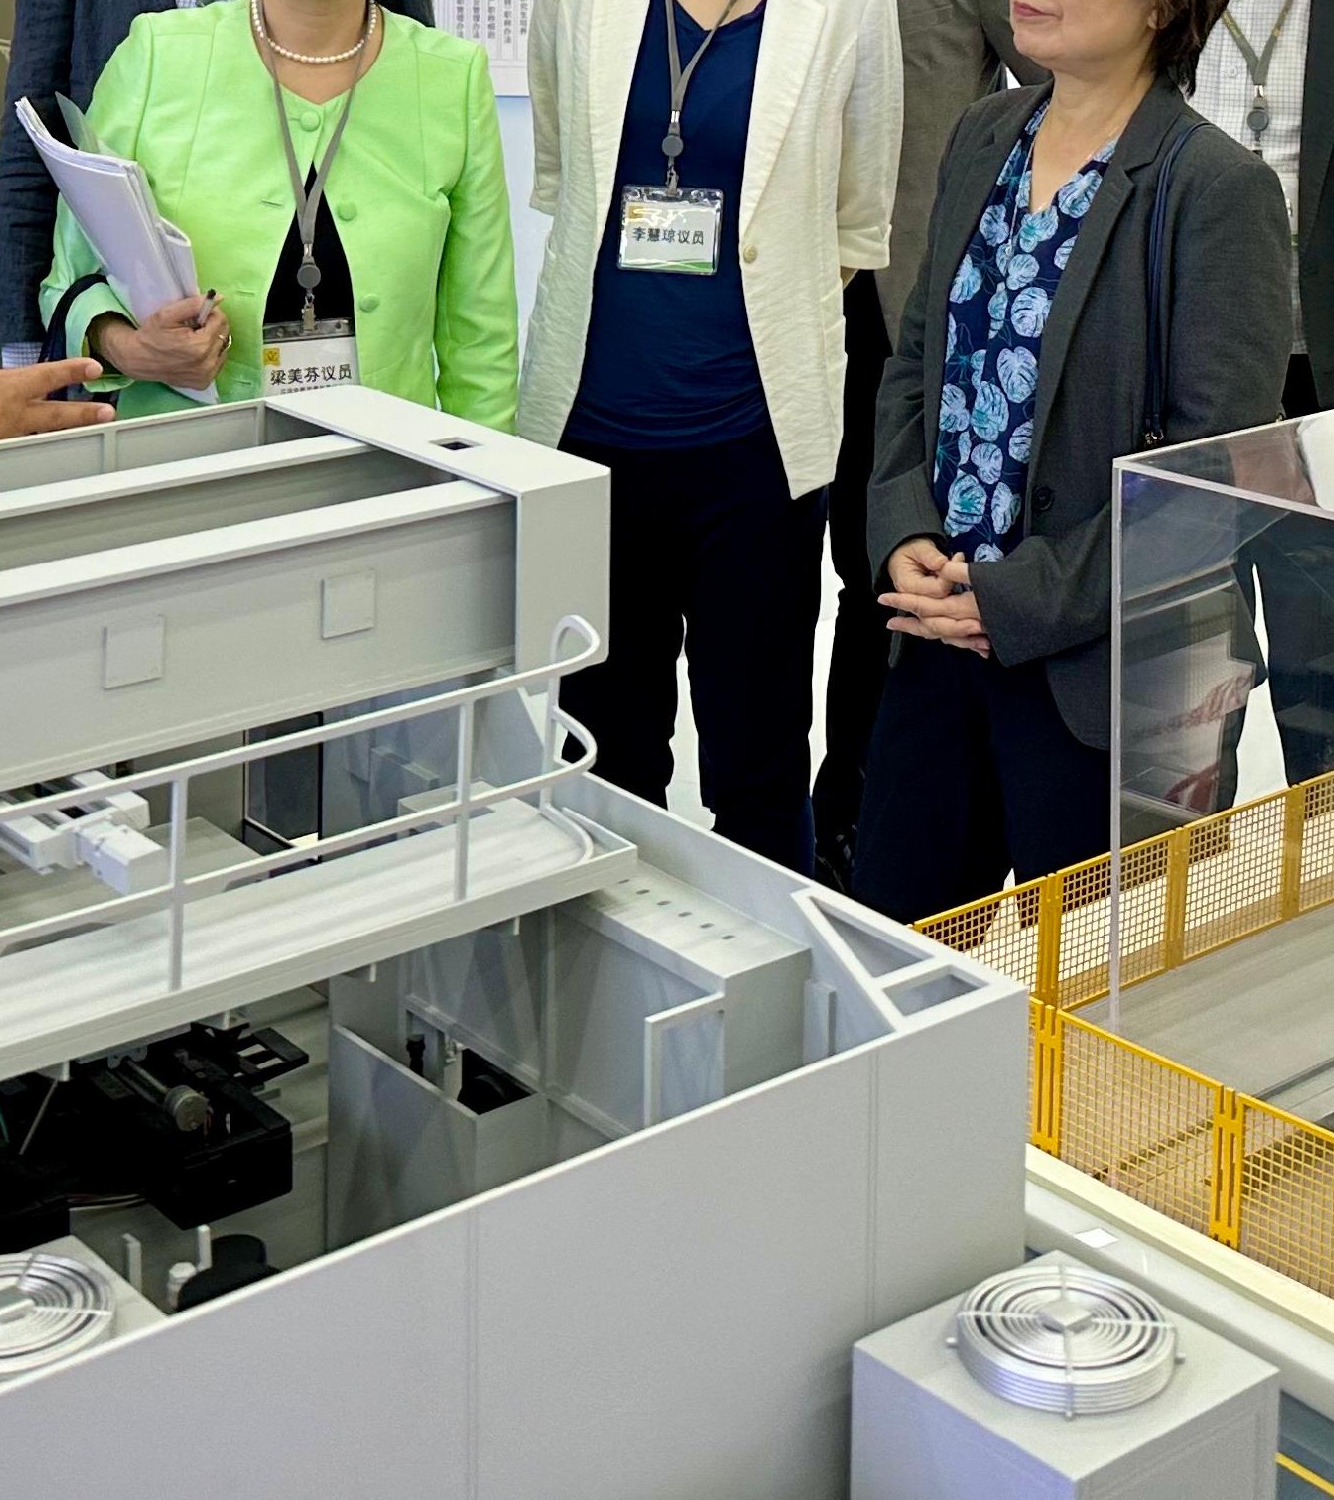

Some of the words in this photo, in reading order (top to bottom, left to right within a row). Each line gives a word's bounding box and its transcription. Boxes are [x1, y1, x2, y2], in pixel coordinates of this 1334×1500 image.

[632, 227, 704, 246] 李慧琼议员
[270, 363, 353, 386] 梁美芬议员
